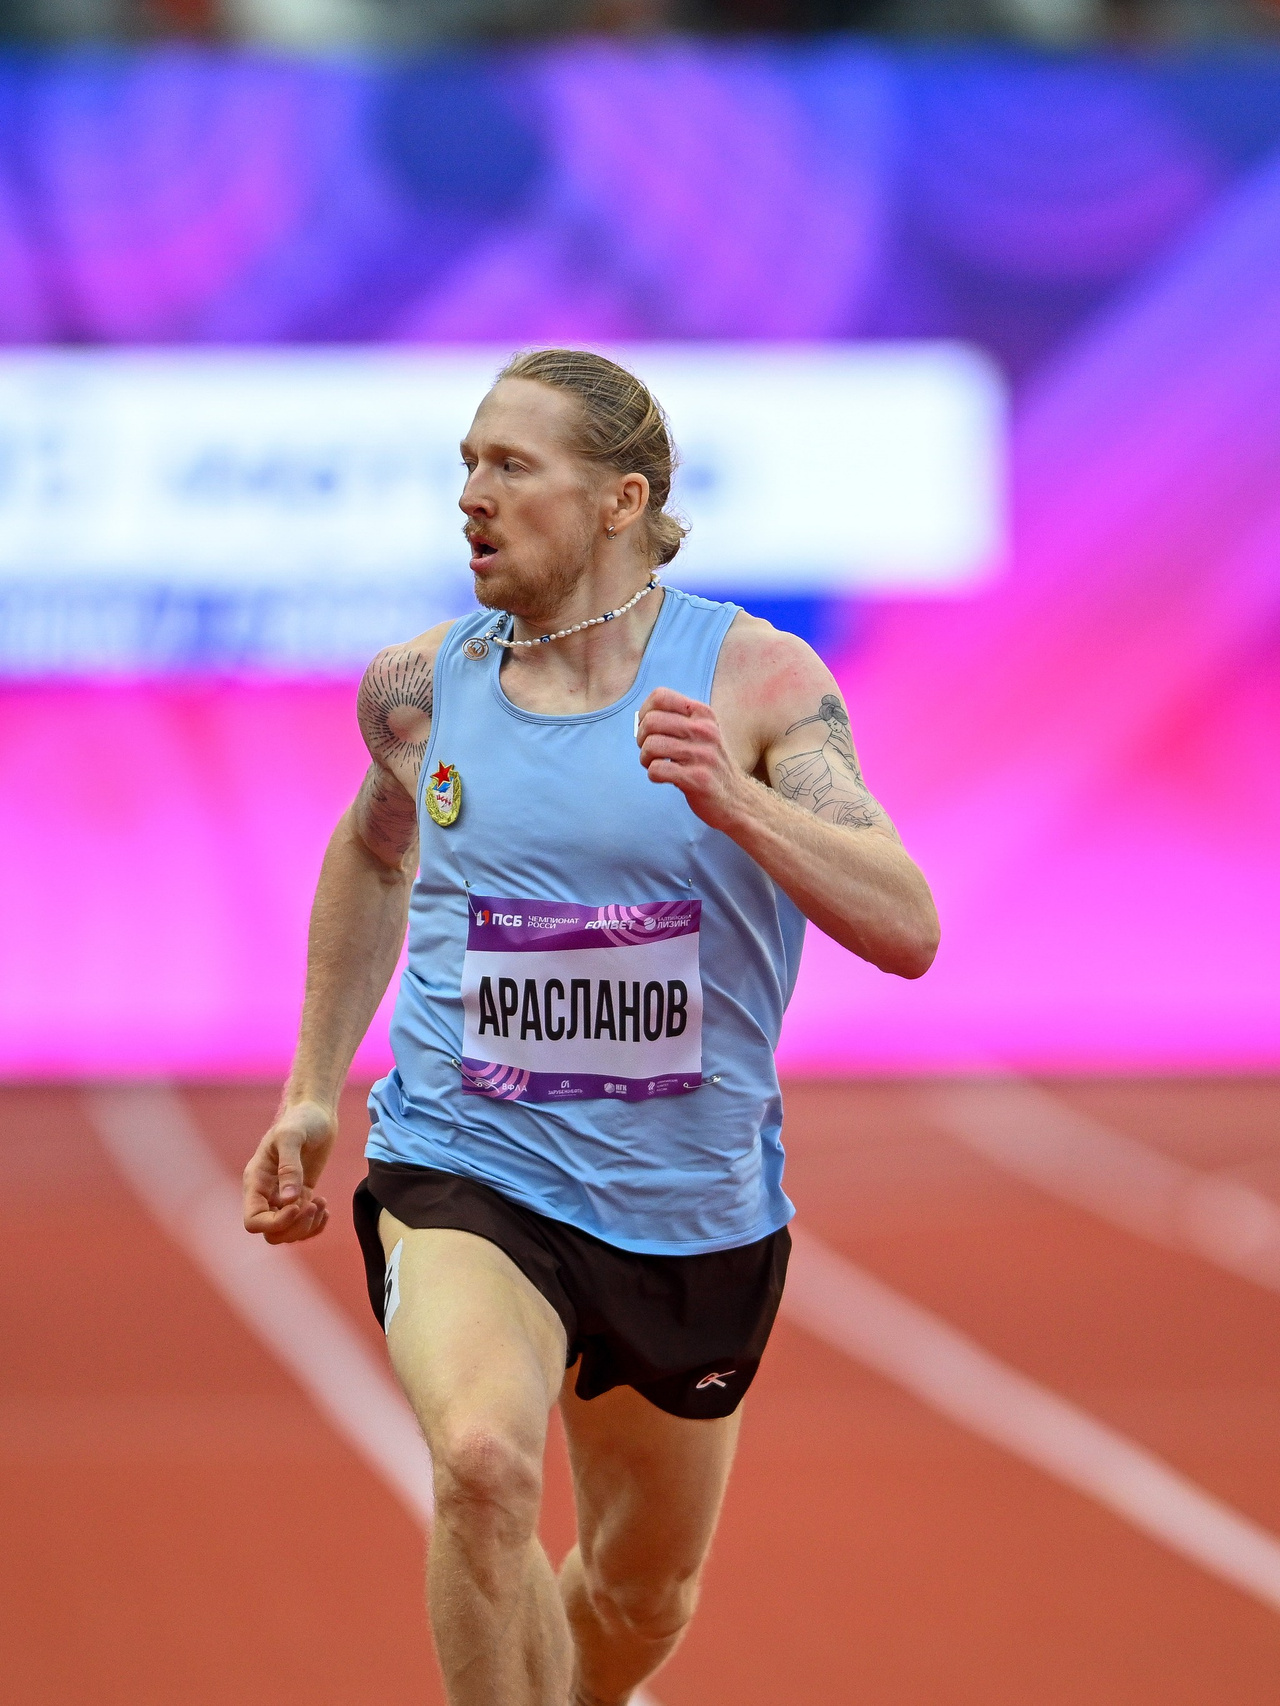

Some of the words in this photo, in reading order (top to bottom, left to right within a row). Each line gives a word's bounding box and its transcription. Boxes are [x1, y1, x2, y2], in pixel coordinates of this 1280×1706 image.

[492, 913, 523, 927] ПСБ
[528, 915, 580, 926] ЧЕМПИОНАТ
[585, 920, 636, 930] FONBET
[657, 919, 691, 929] ЛИЗИНГ
[478, 976, 688, 1043] АРАСЛАНОВ
